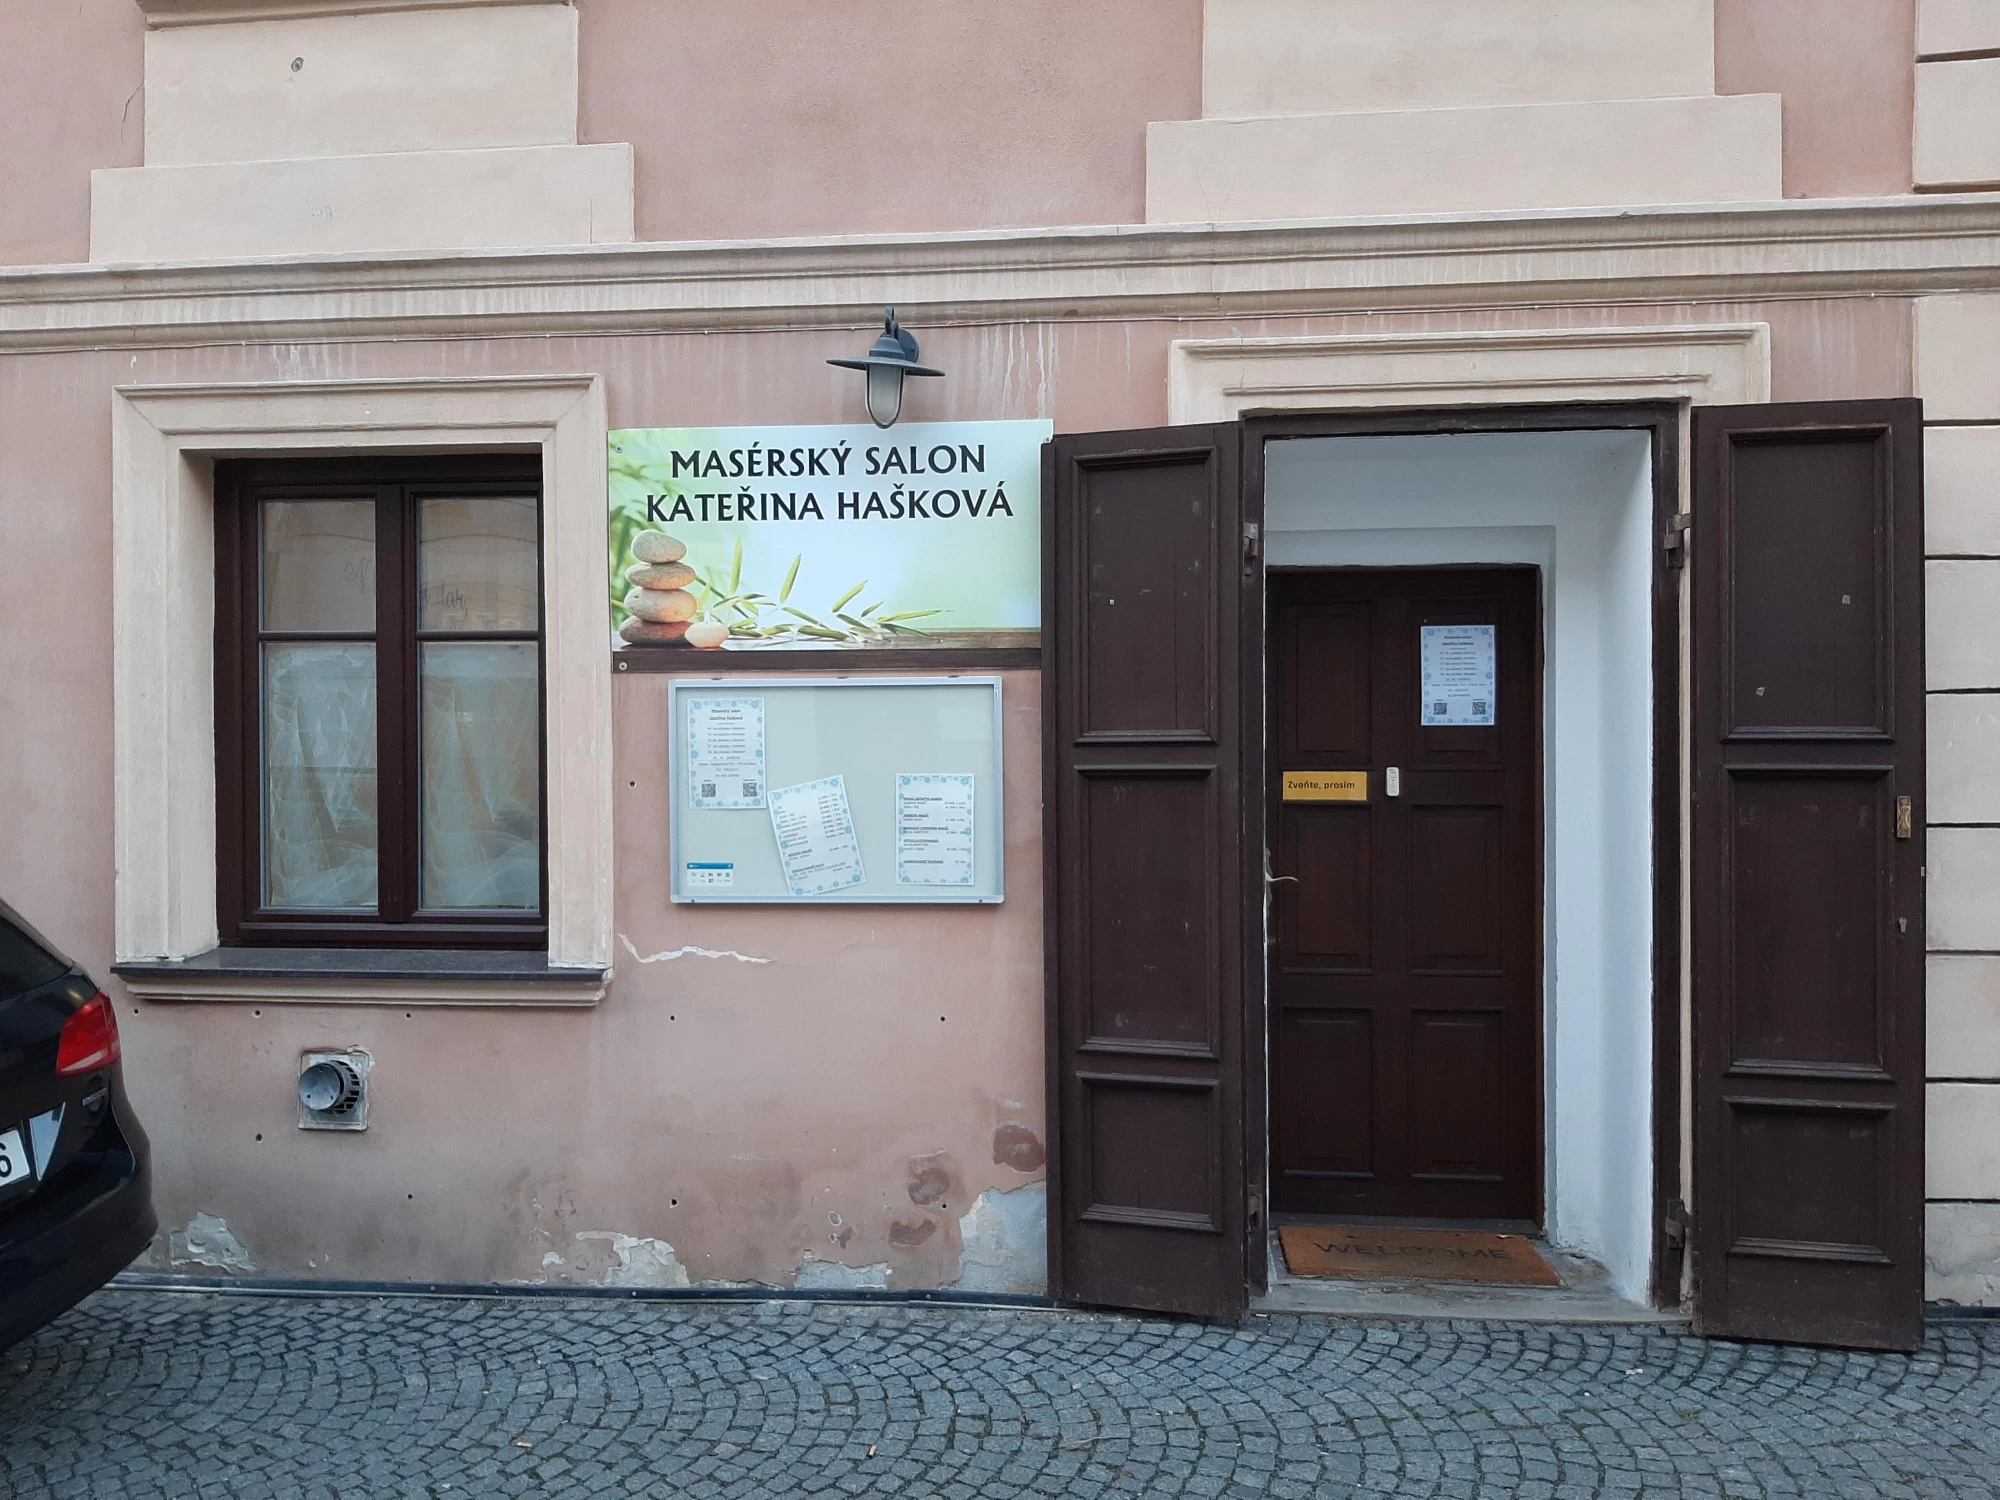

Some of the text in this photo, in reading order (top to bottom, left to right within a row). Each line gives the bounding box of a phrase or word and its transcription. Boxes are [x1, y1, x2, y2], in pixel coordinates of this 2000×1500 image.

[670, 440, 985, 478] MASÉRSKÝ SALON
[647, 481, 1014, 522] KATEŘINA HAŠKOVÁ
[1287, 780, 1355, 790] Zvoňte, prosím
[1313, 1241, 1509, 1260] WELCOME
